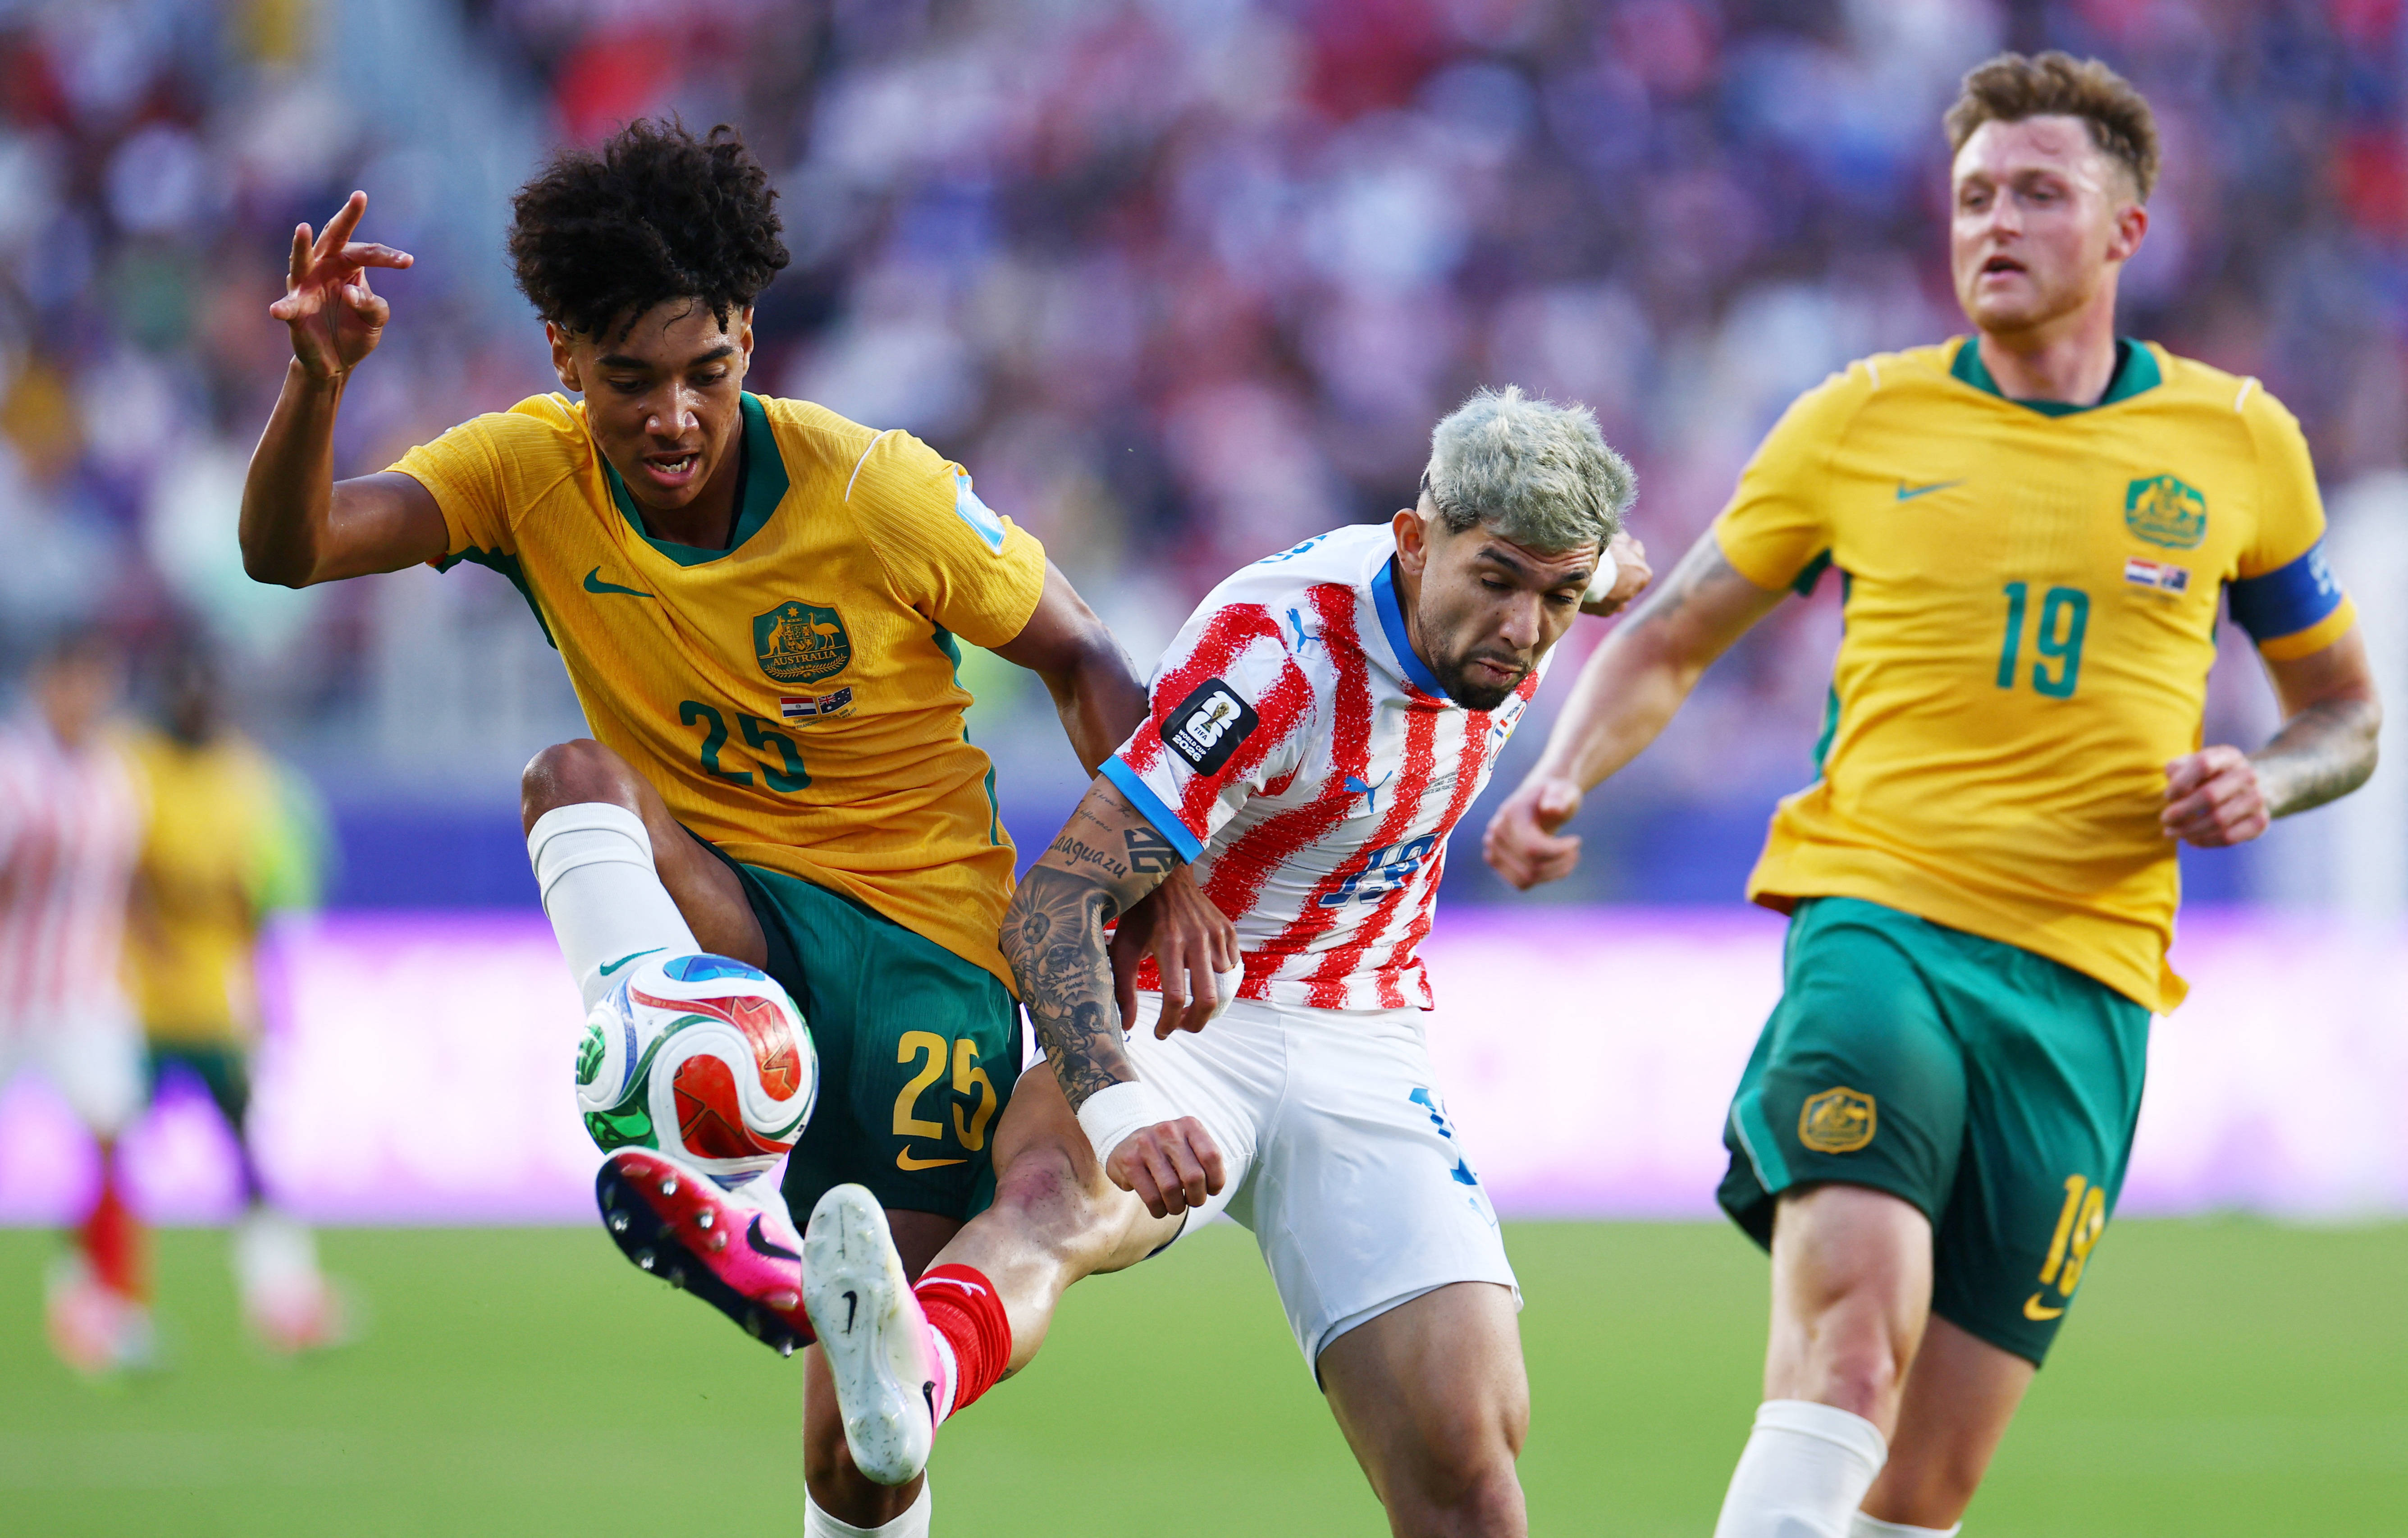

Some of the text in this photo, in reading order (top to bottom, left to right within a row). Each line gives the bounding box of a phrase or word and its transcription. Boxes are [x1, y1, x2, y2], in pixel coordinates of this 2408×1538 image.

[772, 650, 837, 666] AUSTRALIA
[1996, 581, 2090, 699] 19
[679, 700, 812, 792] 25
[1172, 734, 1202, 762] 2026
[1178, 729, 1207, 755] WORLD CUP
[1194, 727, 1208, 741] FIFA
[892, 1030, 996, 1151] 25
[2039, 1173, 2105, 1297] 19
